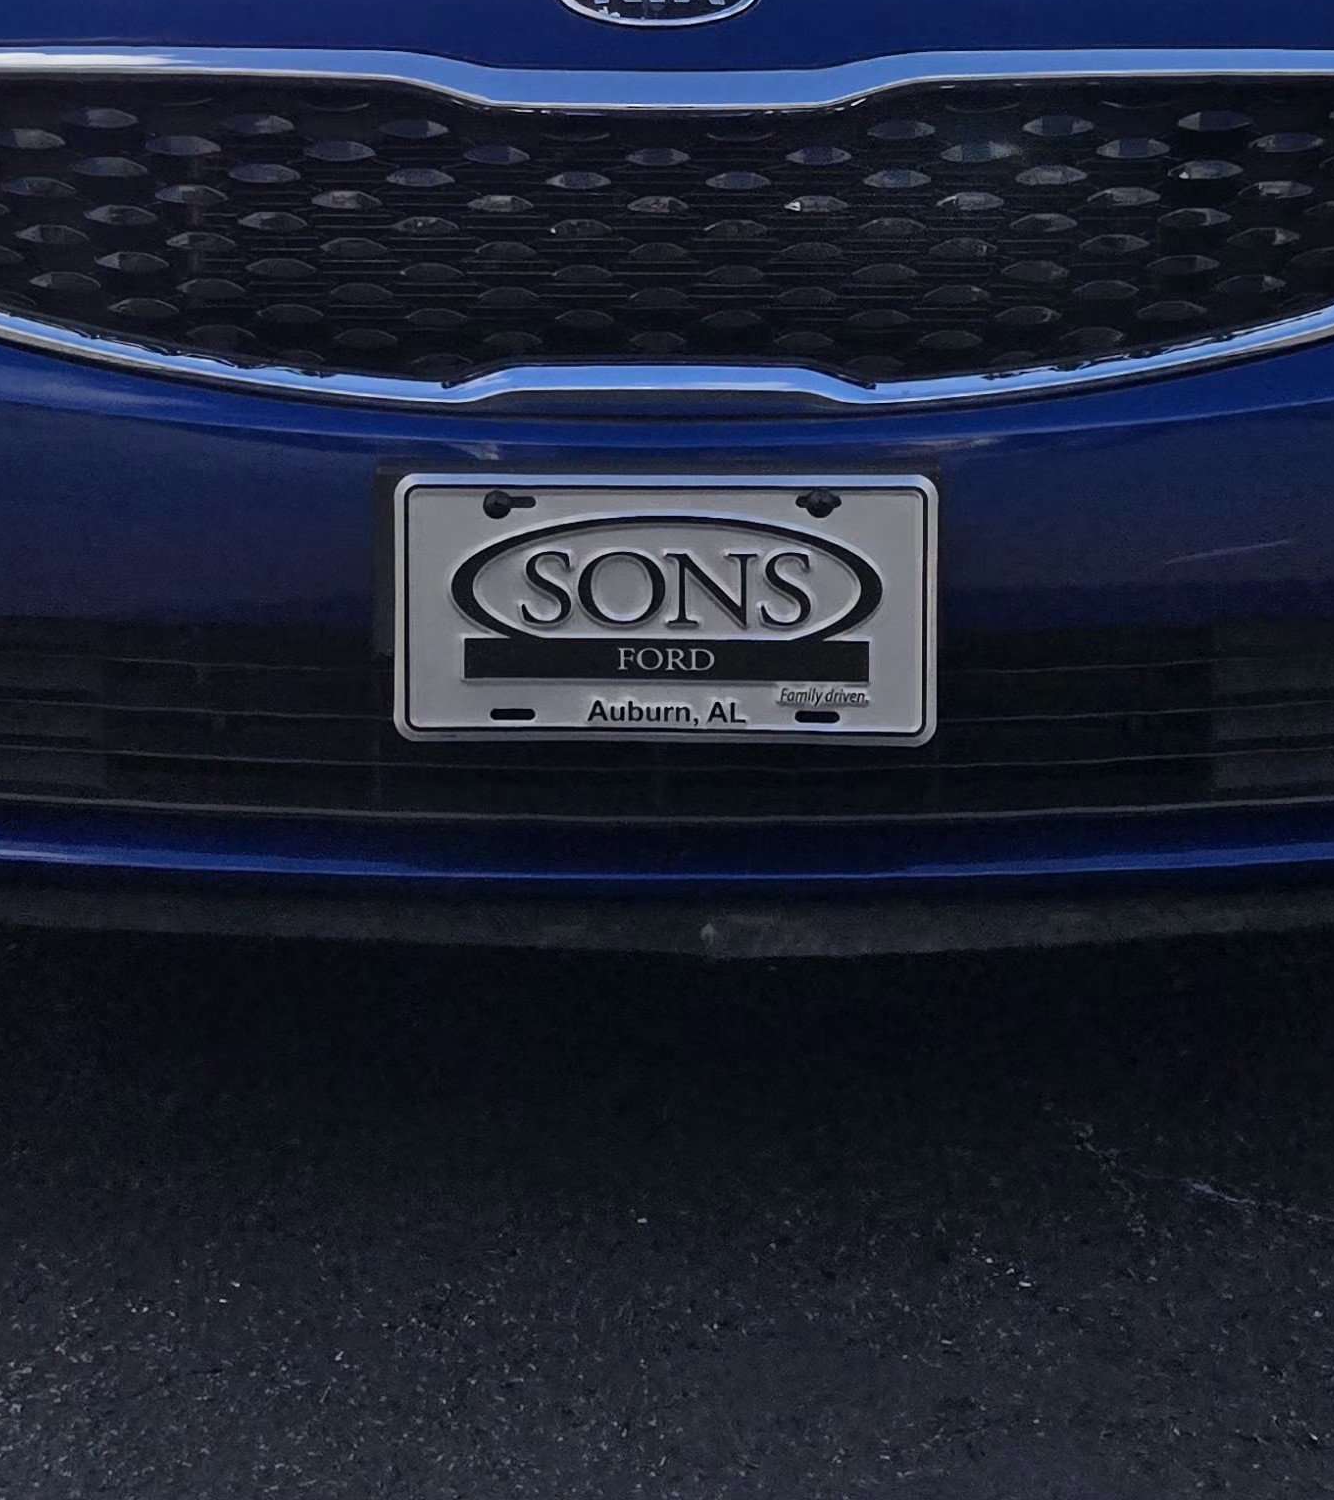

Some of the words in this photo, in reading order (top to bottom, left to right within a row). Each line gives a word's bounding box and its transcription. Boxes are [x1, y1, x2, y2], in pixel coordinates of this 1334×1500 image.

[521, 550, 811, 628] SONS
[618, 647, 715, 671] FORD
[780, 687, 824, 707] Family
[825, 687, 870, 704] driven.
[587, 699, 699, 727] Auburn,
[707, 701, 747, 723] AL
